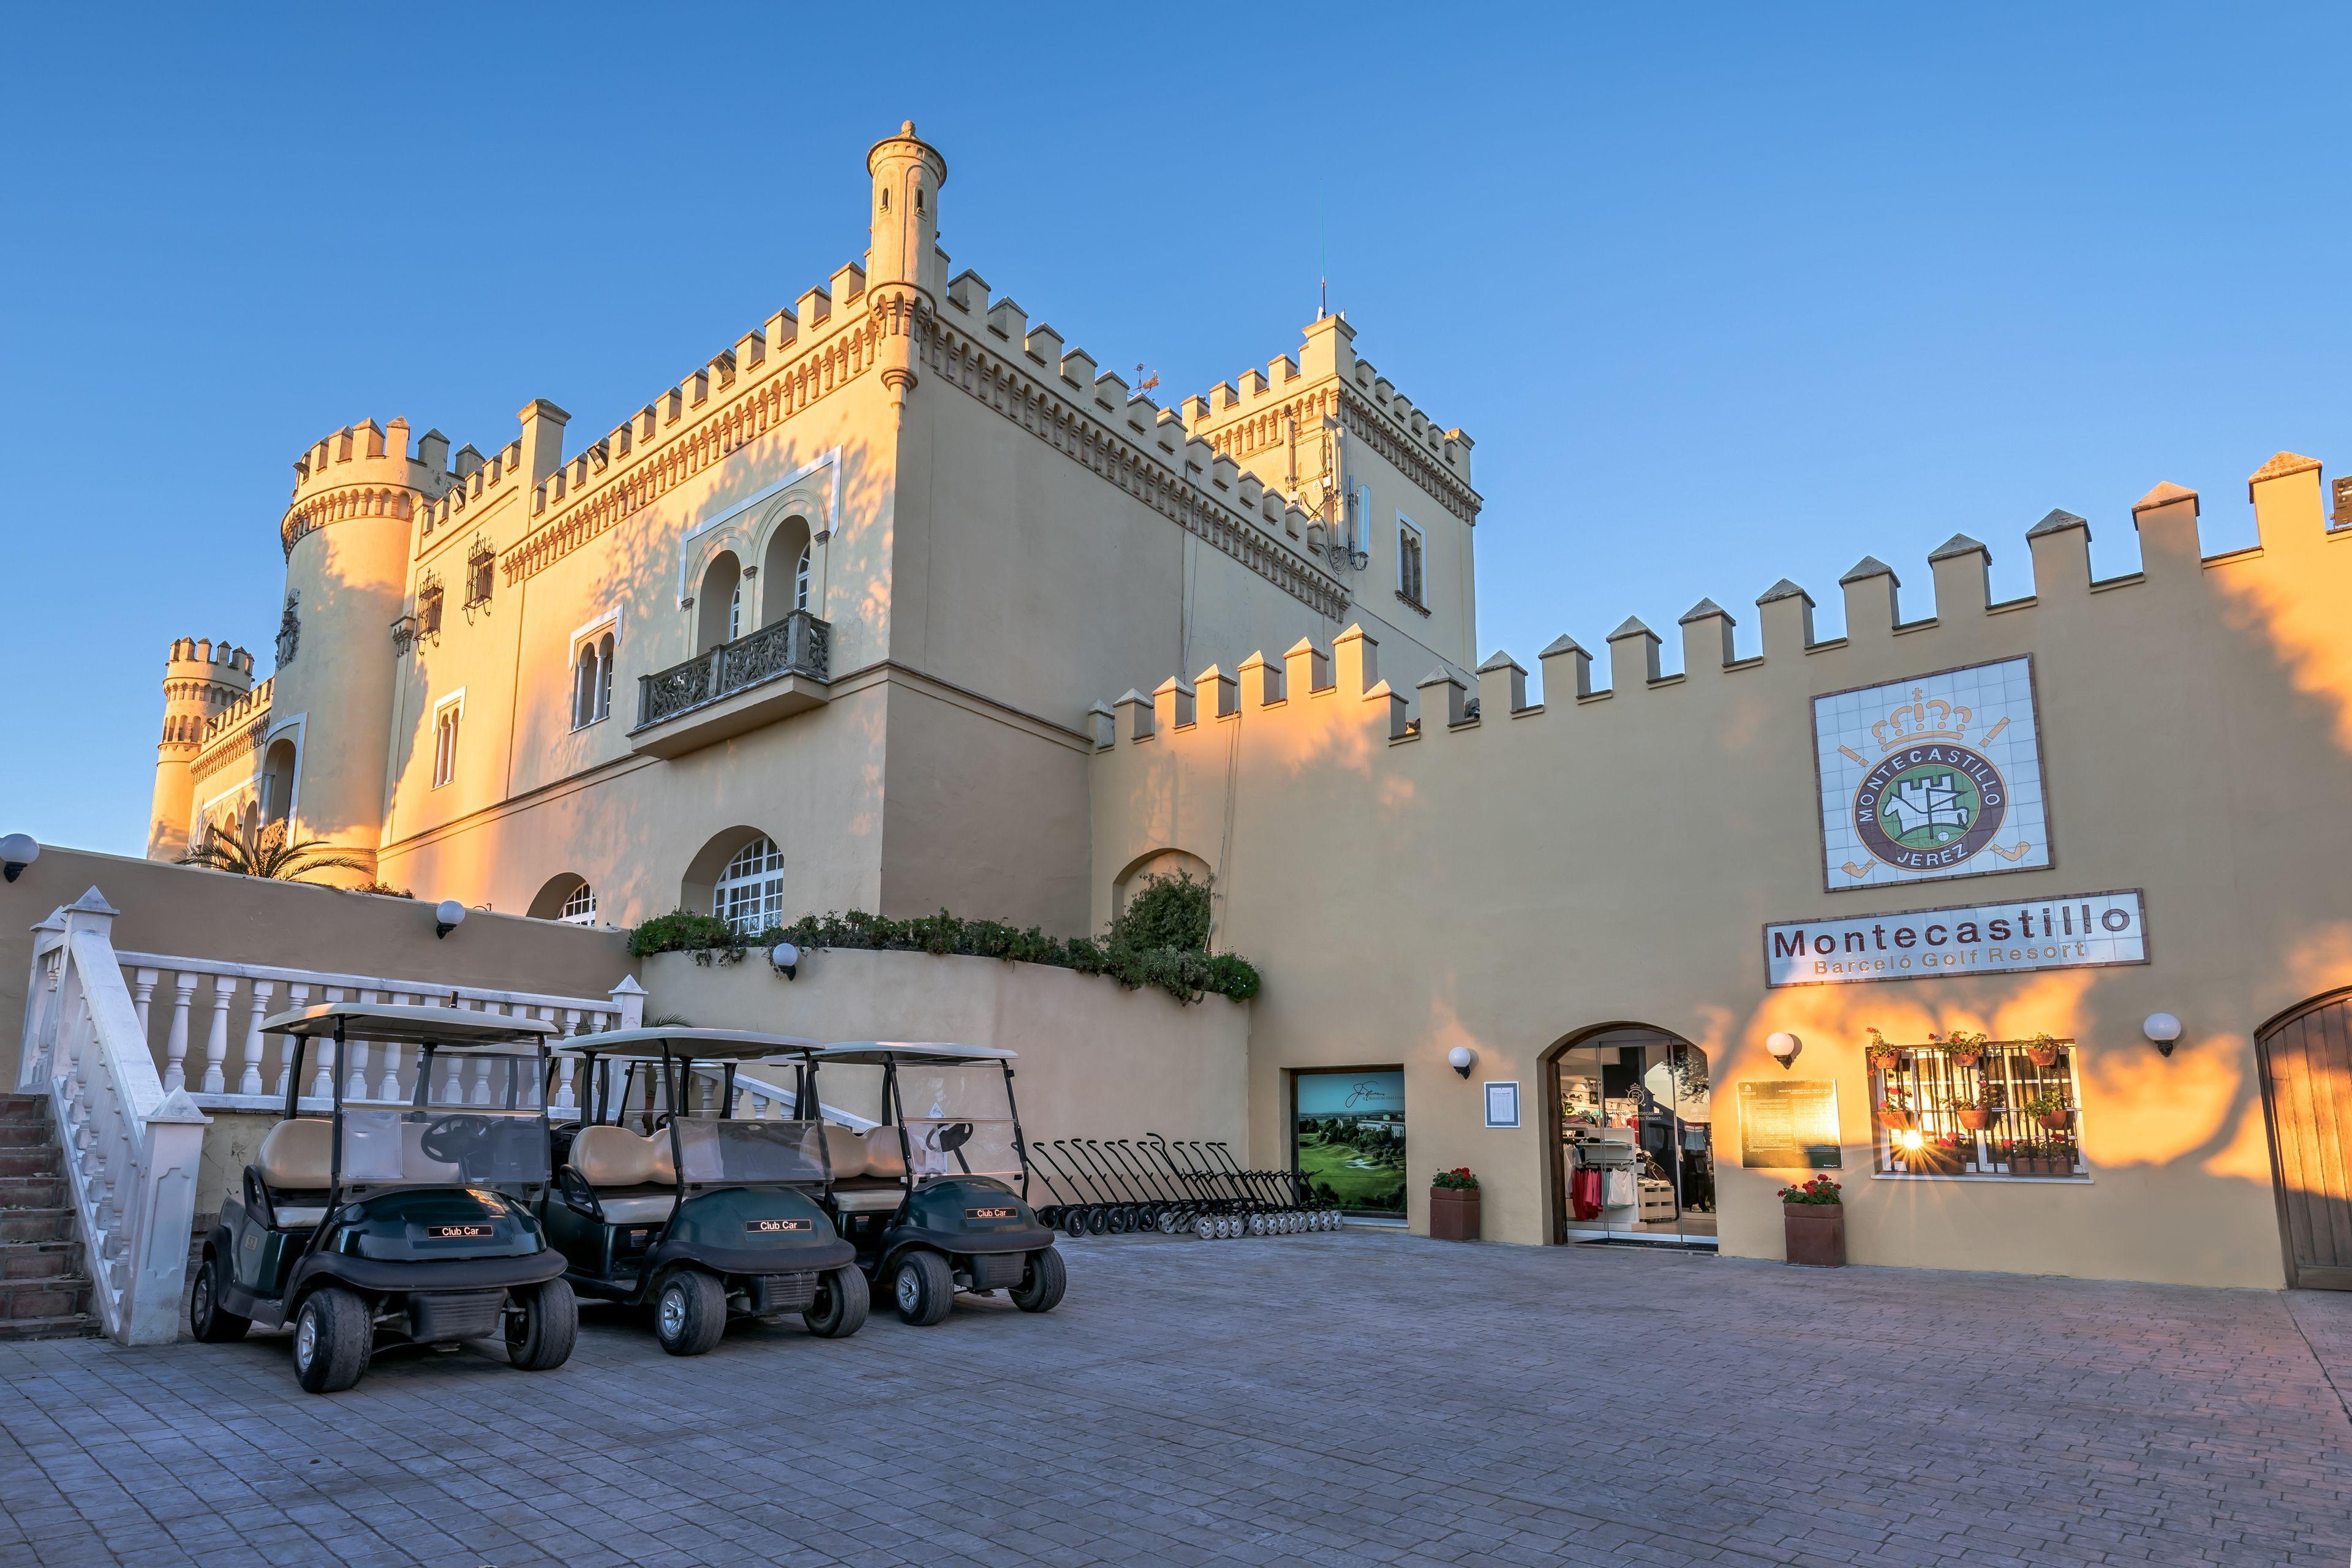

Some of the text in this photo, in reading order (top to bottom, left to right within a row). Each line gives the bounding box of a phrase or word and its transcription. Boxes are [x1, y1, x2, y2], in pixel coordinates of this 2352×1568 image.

[1859, 748, 2000, 822] MONTECASTILLO
[1897, 842, 1969, 866] JEREZ
[1774, 904, 2130, 958] Montecastillo
[1814, 941, 2084, 975] Barceló Golf Resort
[442, 1227, 462, 1236] Club
[760, 1221, 780, 1230] Club
